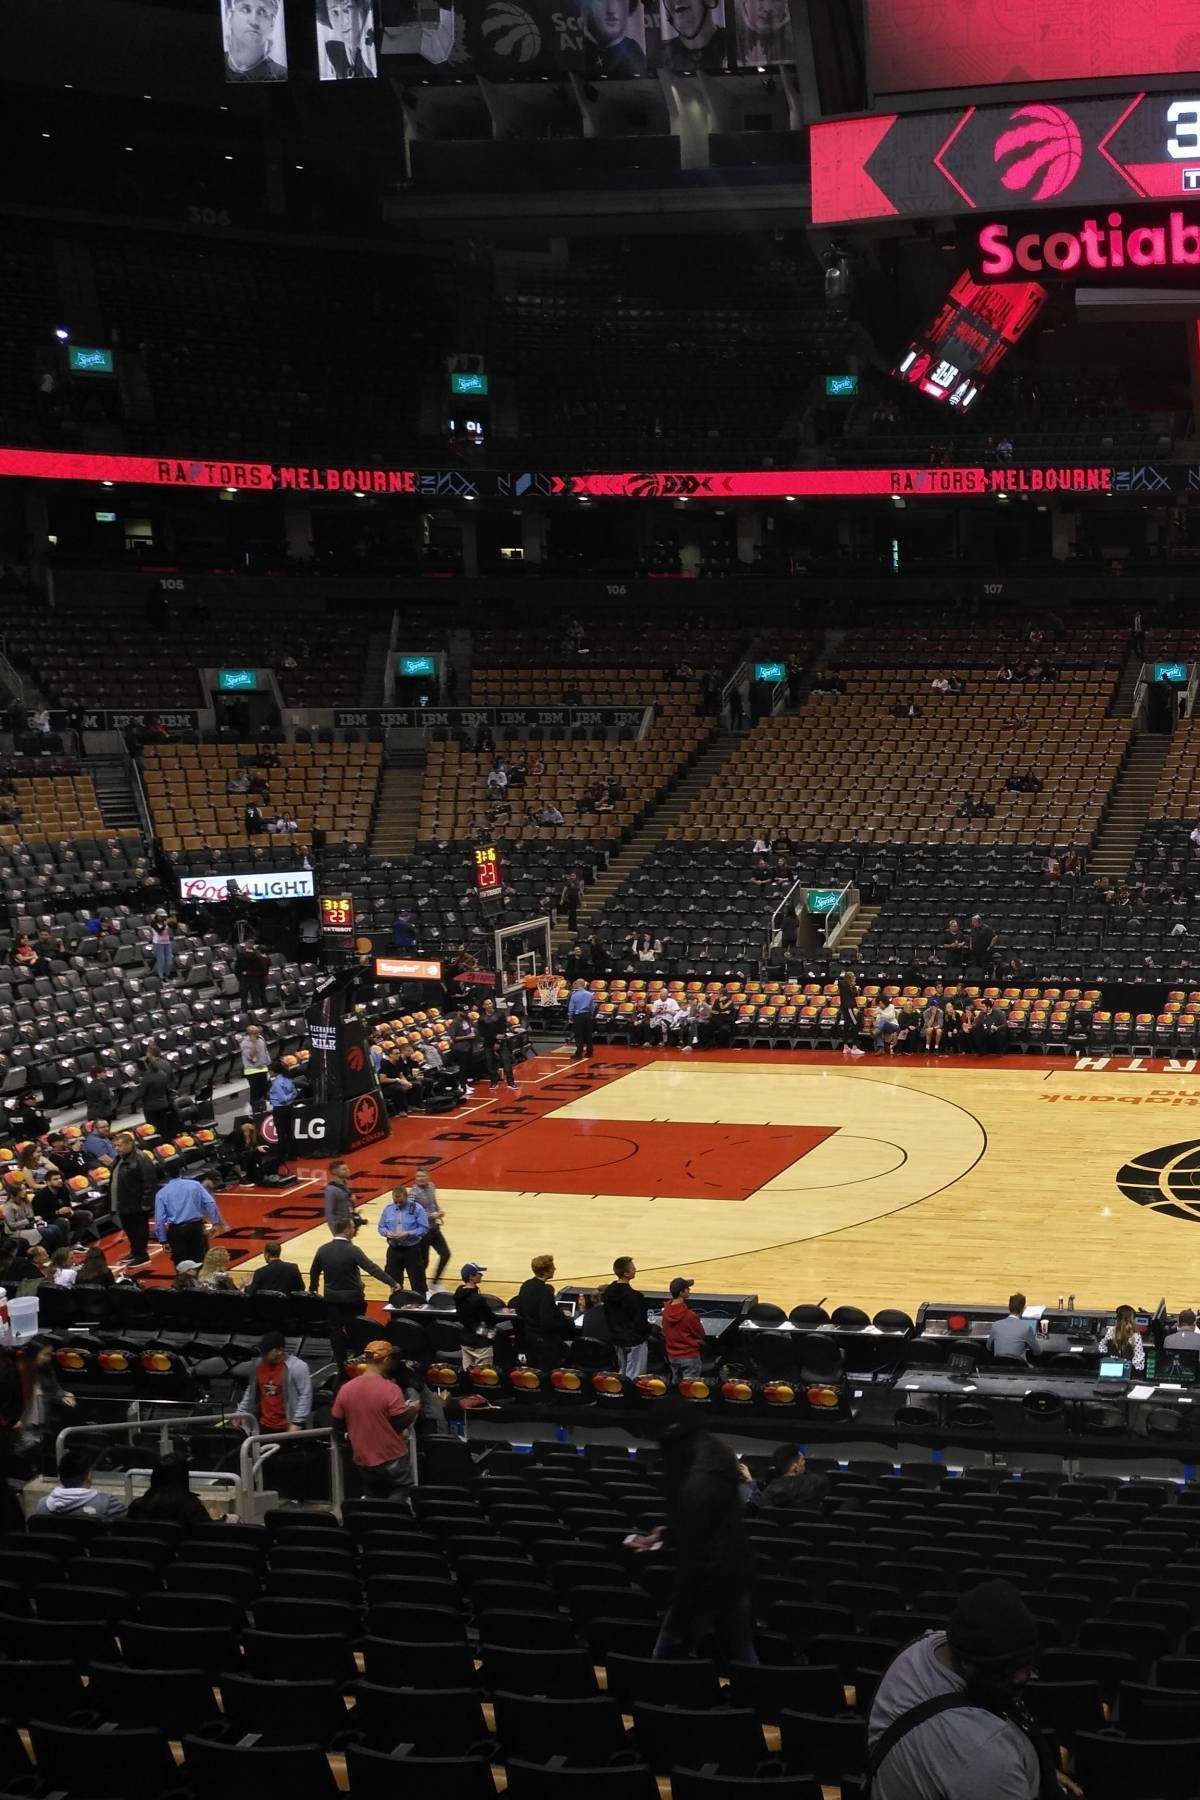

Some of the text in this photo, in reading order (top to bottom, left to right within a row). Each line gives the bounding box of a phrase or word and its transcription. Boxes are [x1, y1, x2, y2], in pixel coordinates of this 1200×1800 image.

[188, 206, 231, 225] 306
[279, 466, 415, 492] MELBOURNE
[991, 468, 1112, 490] MELBOURNE
[160, 579, 184, 590] 105
[606, 584, 627, 594] 106
[984, 584, 1003, 594] 107
[160, 714, 192, 727] IBM
[340, 713, 368, 726] IBM
[380, 713, 408, 726] IBM
[421, 713, 449, 725] IBM
[461, 712, 489, 725] IBM
[500, 712, 526, 724] IBM
[538, 712, 564, 724] IBM
[613, 712, 641, 724] IBM
[480, 862, 496, 886] 23
[185, 880, 308, 900] Coos LIGHT
[329, 910, 346, 923] 23
[431, 1062, 639, 1143] RAPTORS
[294, 1117, 326, 1140] LG
